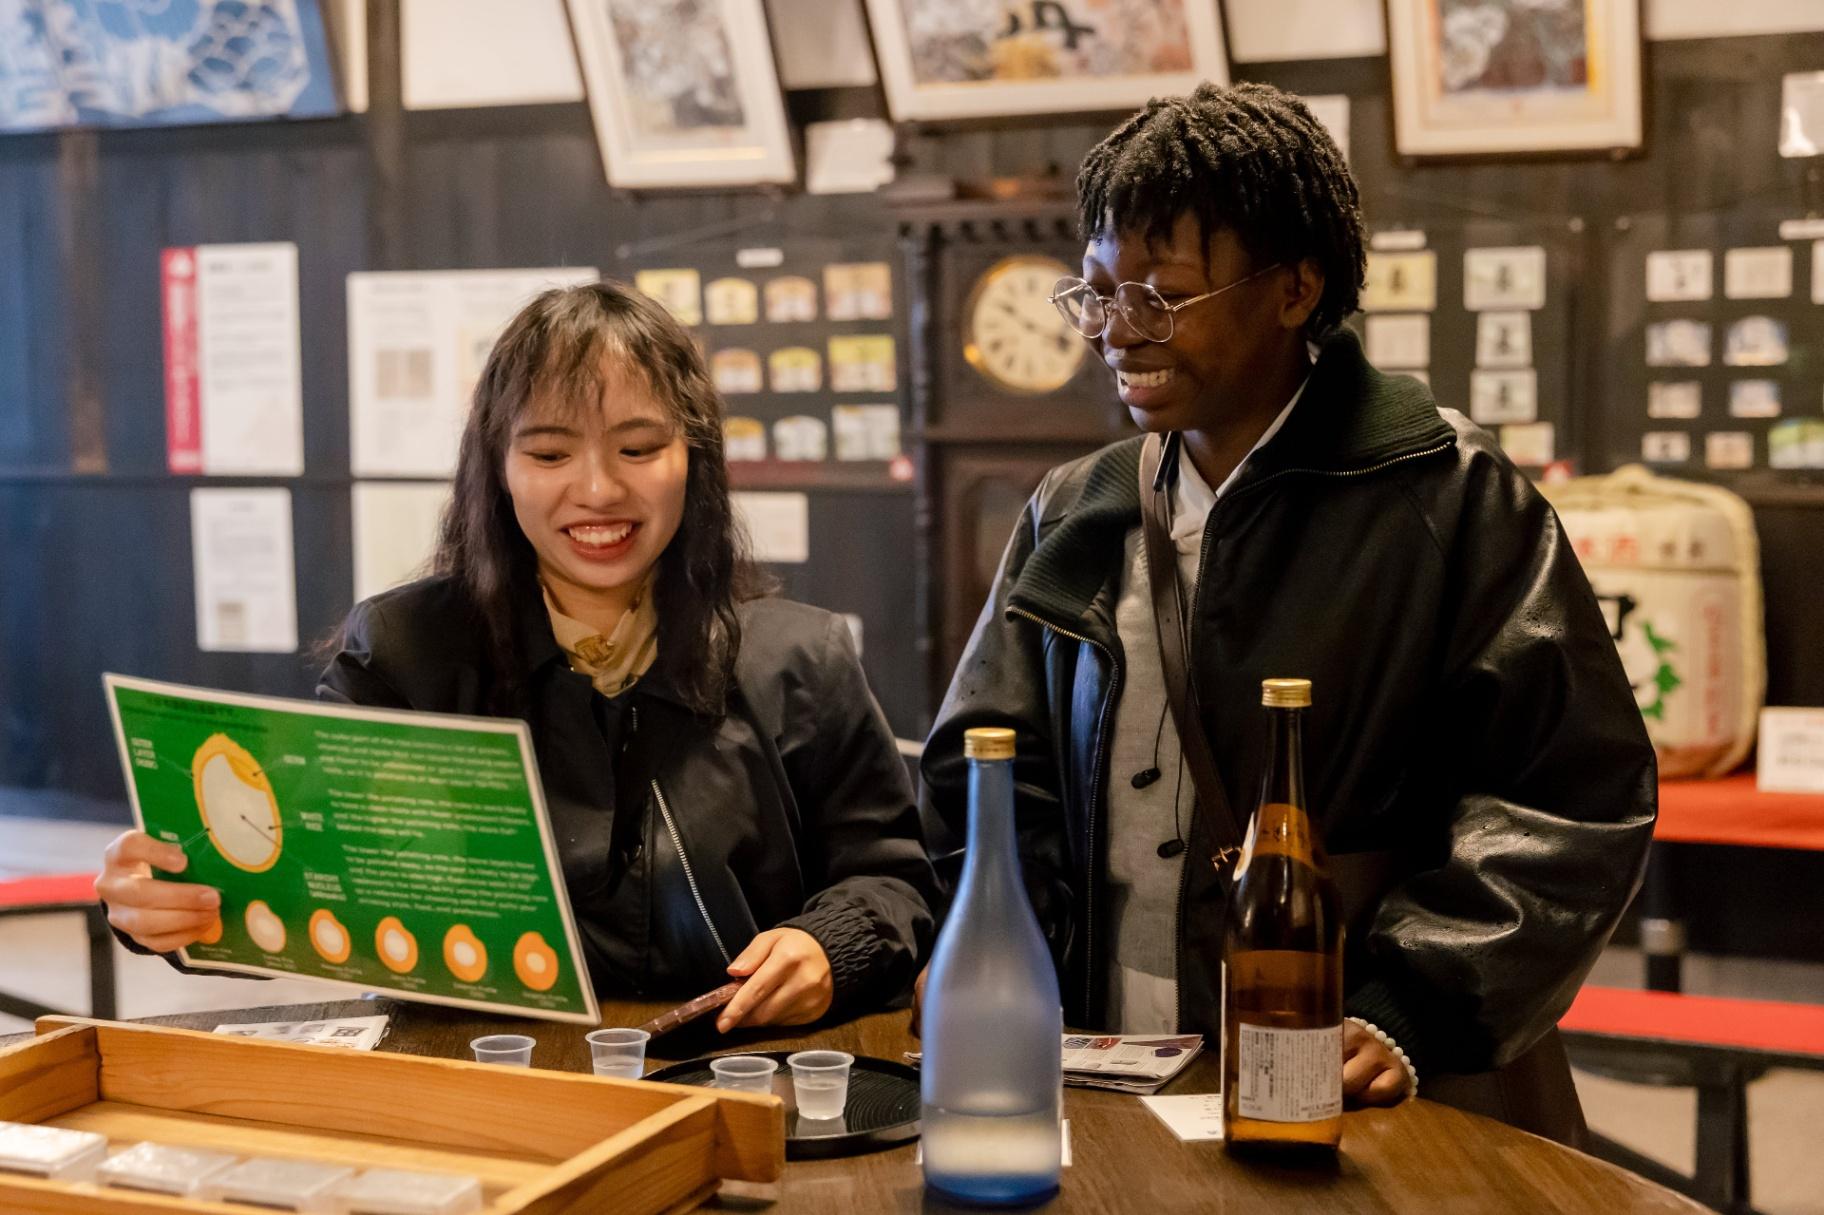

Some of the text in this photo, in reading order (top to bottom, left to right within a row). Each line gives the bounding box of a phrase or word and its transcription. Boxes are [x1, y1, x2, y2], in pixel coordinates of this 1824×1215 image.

[328, 788, 342, 797] The
[366, 793, 379, 801] the
[381, 794, 416, 804] polishing
[405, 818, 440, 828] polishing
[341, 844, 357, 852] The
[359, 846, 378, 855] lower
[380, 848, 394, 856] the
[396, 850, 430, 860] polishing
[431, 853, 449, 861] rate,
[452, 855, 465, 863] the
[467, 857, 486, 865] more
[304, 872, 339, 882] STARCHY
[493, 891, 528, 900] polishing
